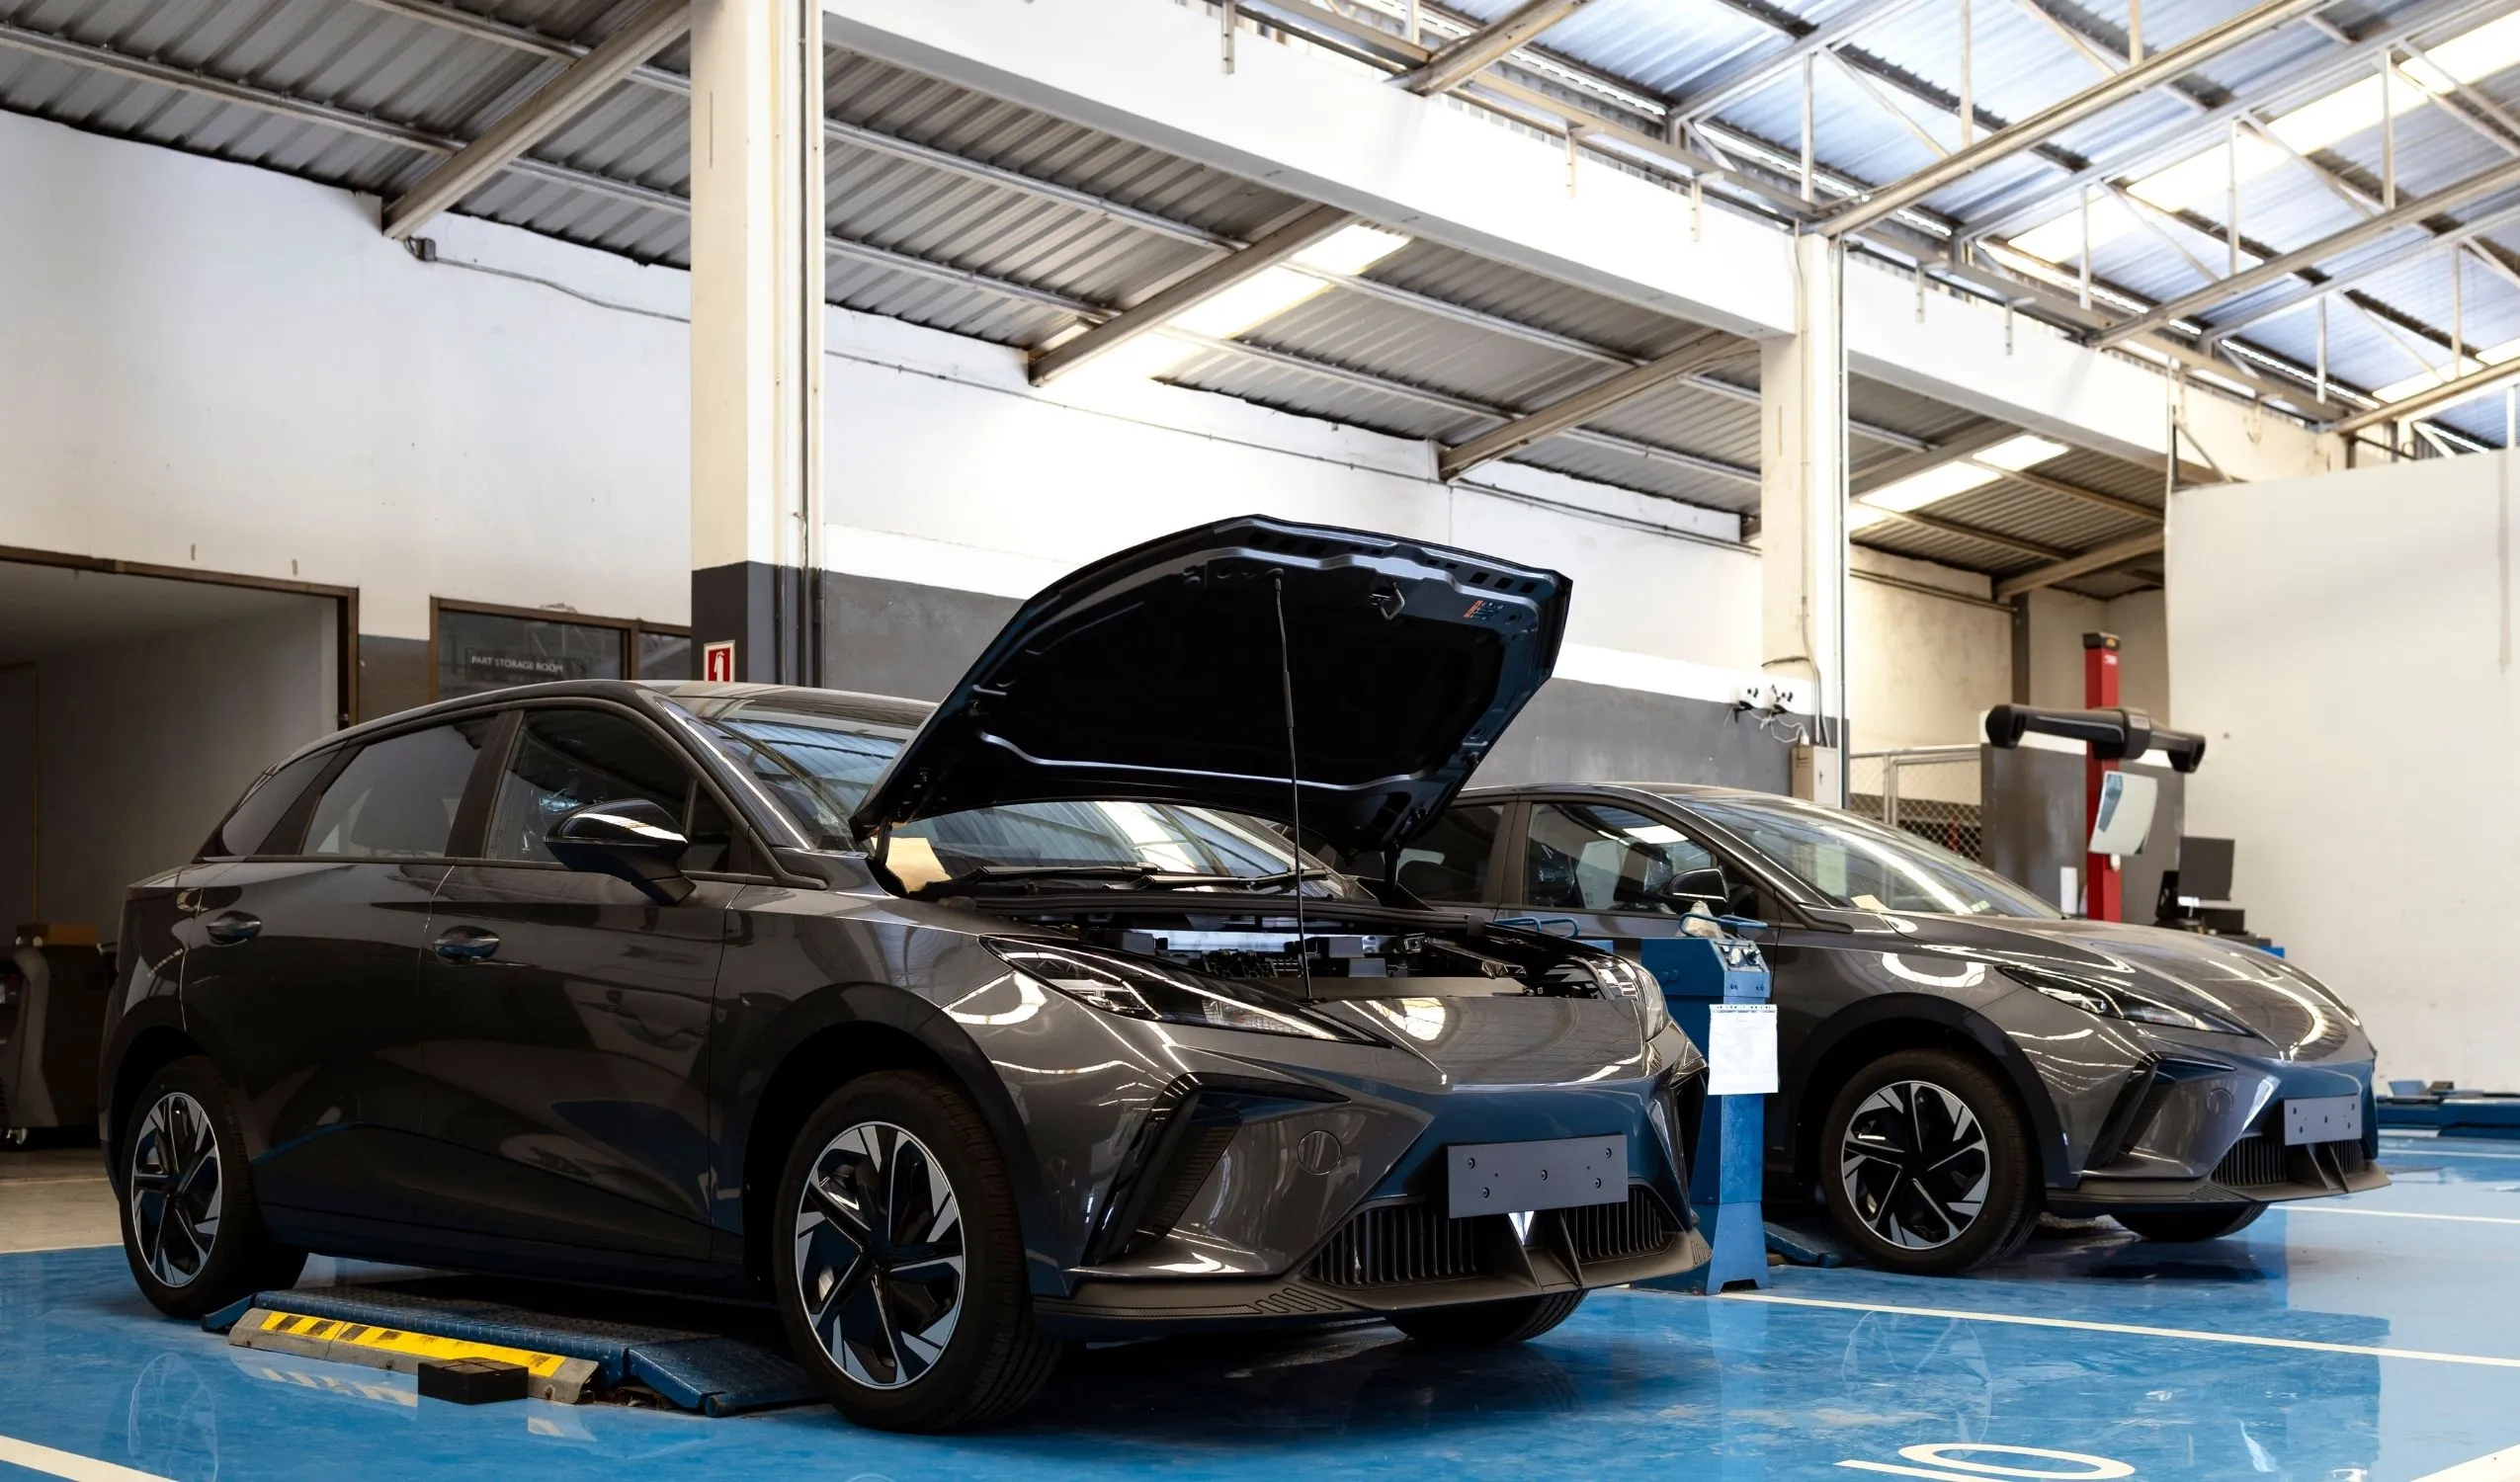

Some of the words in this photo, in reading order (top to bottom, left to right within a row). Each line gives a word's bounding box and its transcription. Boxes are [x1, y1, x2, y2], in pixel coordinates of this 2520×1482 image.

[471, 655, 493, 666] PART
[494, 658, 534, 670] STORAGE
[536, 662, 563, 673] ROOM
